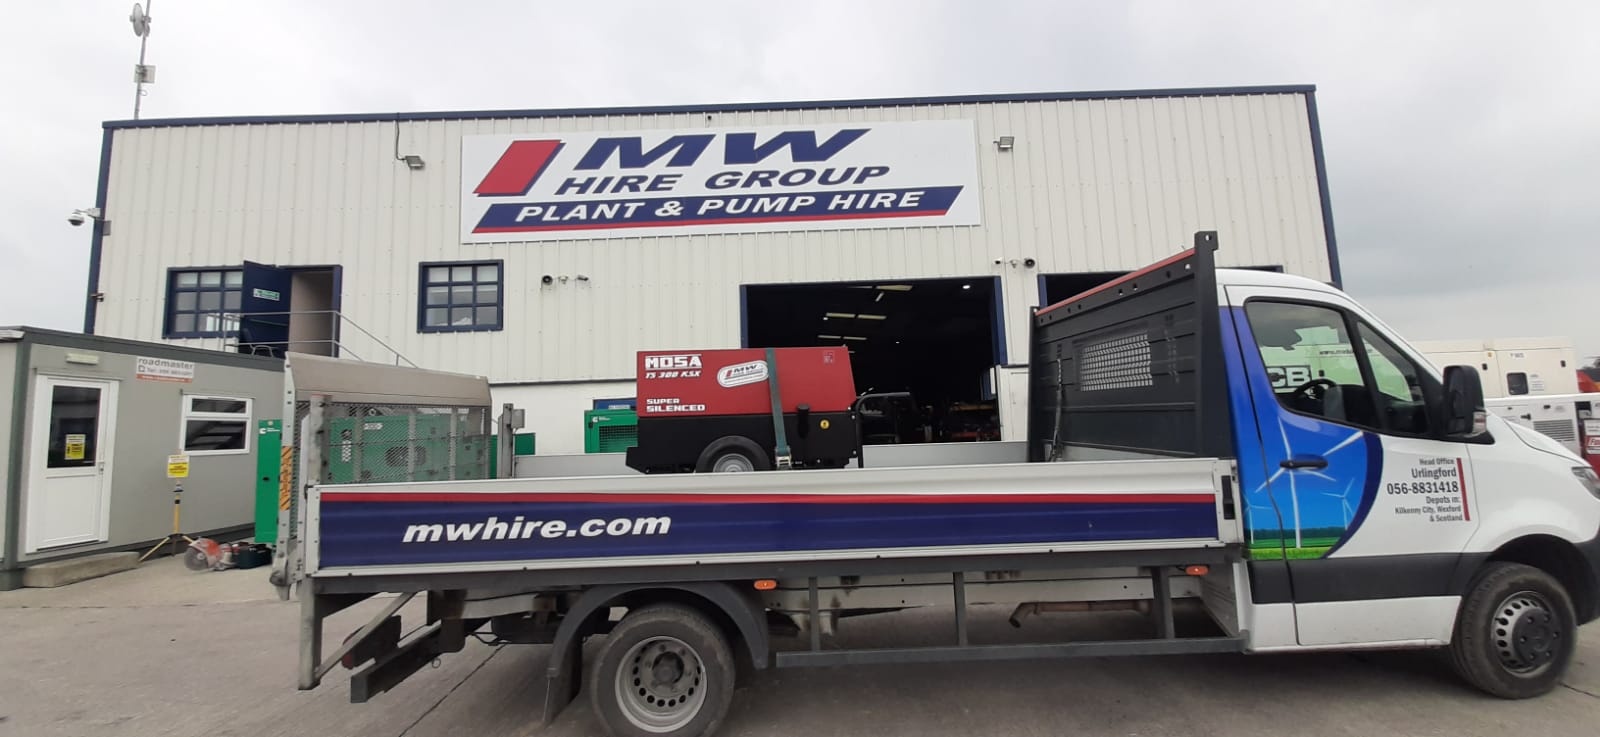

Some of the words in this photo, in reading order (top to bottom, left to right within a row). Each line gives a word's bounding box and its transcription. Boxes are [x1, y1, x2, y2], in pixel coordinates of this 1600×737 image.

[573, 128, 872, 170] MW
[554, 174, 684, 195] HIRE
[704, 166, 890, 189] GROUP
[515, 202, 645, 222] PLANT
[655, 200, 684, 217] &
[697, 195, 816, 215] PUMP
[827, 191, 925, 210] HIRE
[138, 358, 193, 369] roadmaster
[645, 354, 702, 370] MOSA
[1267, 367, 1311, 388] CB
[646, 404, 705, 412] SILENCED
[1436, 457, 1454, 465] Office
[1411, 467, 1457, 480] Urlingford
[1387, 481, 1459, 495] 056-8831418
[1425, 496, 1450, 505] Depots
[1395, 507, 1421, 515] Kilkenny
[403, 516, 671, 543] mwhire.com
